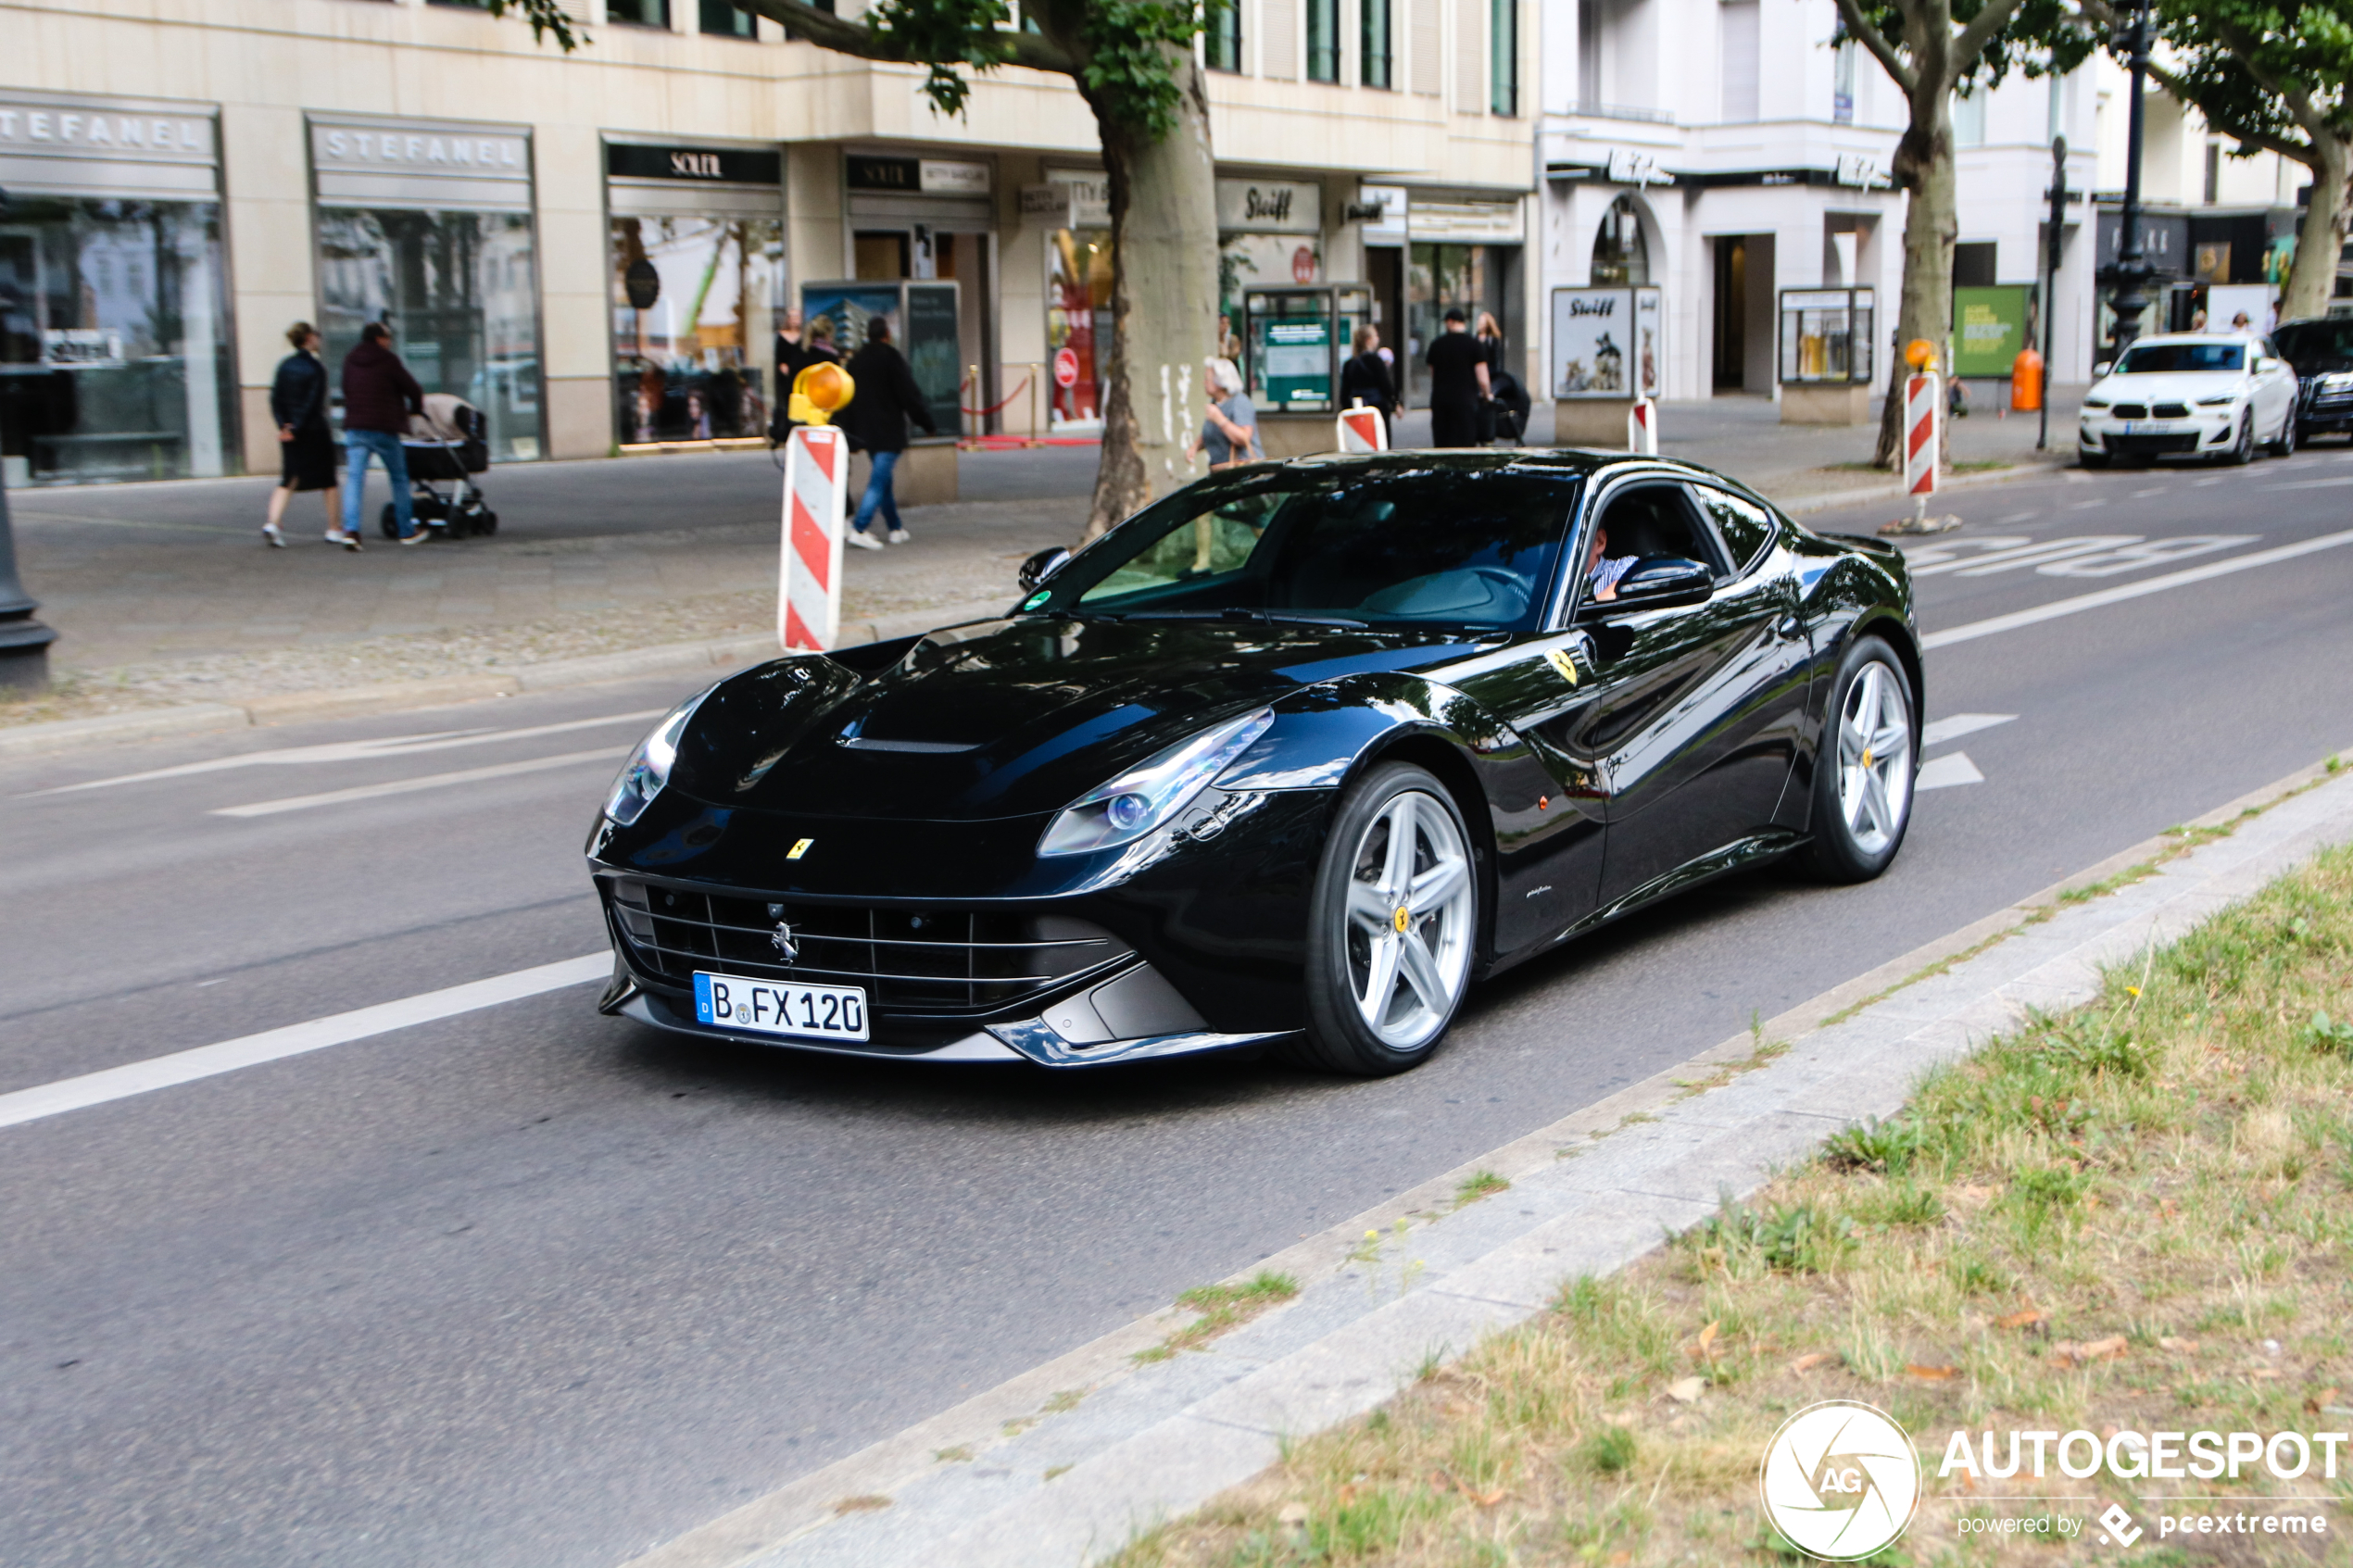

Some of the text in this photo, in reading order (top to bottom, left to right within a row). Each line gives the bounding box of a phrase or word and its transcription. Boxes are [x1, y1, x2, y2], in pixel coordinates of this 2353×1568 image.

[0, 109, 199, 149] TEFANEL
[326, 131, 516, 166] STEFANEL
[1245, 186, 1292, 220] Steiff
[1569, 297, 1615, 318] Steiff
[701, 1002, 710, 1013] D
[712, 982, 862, 1033] B FX 120
